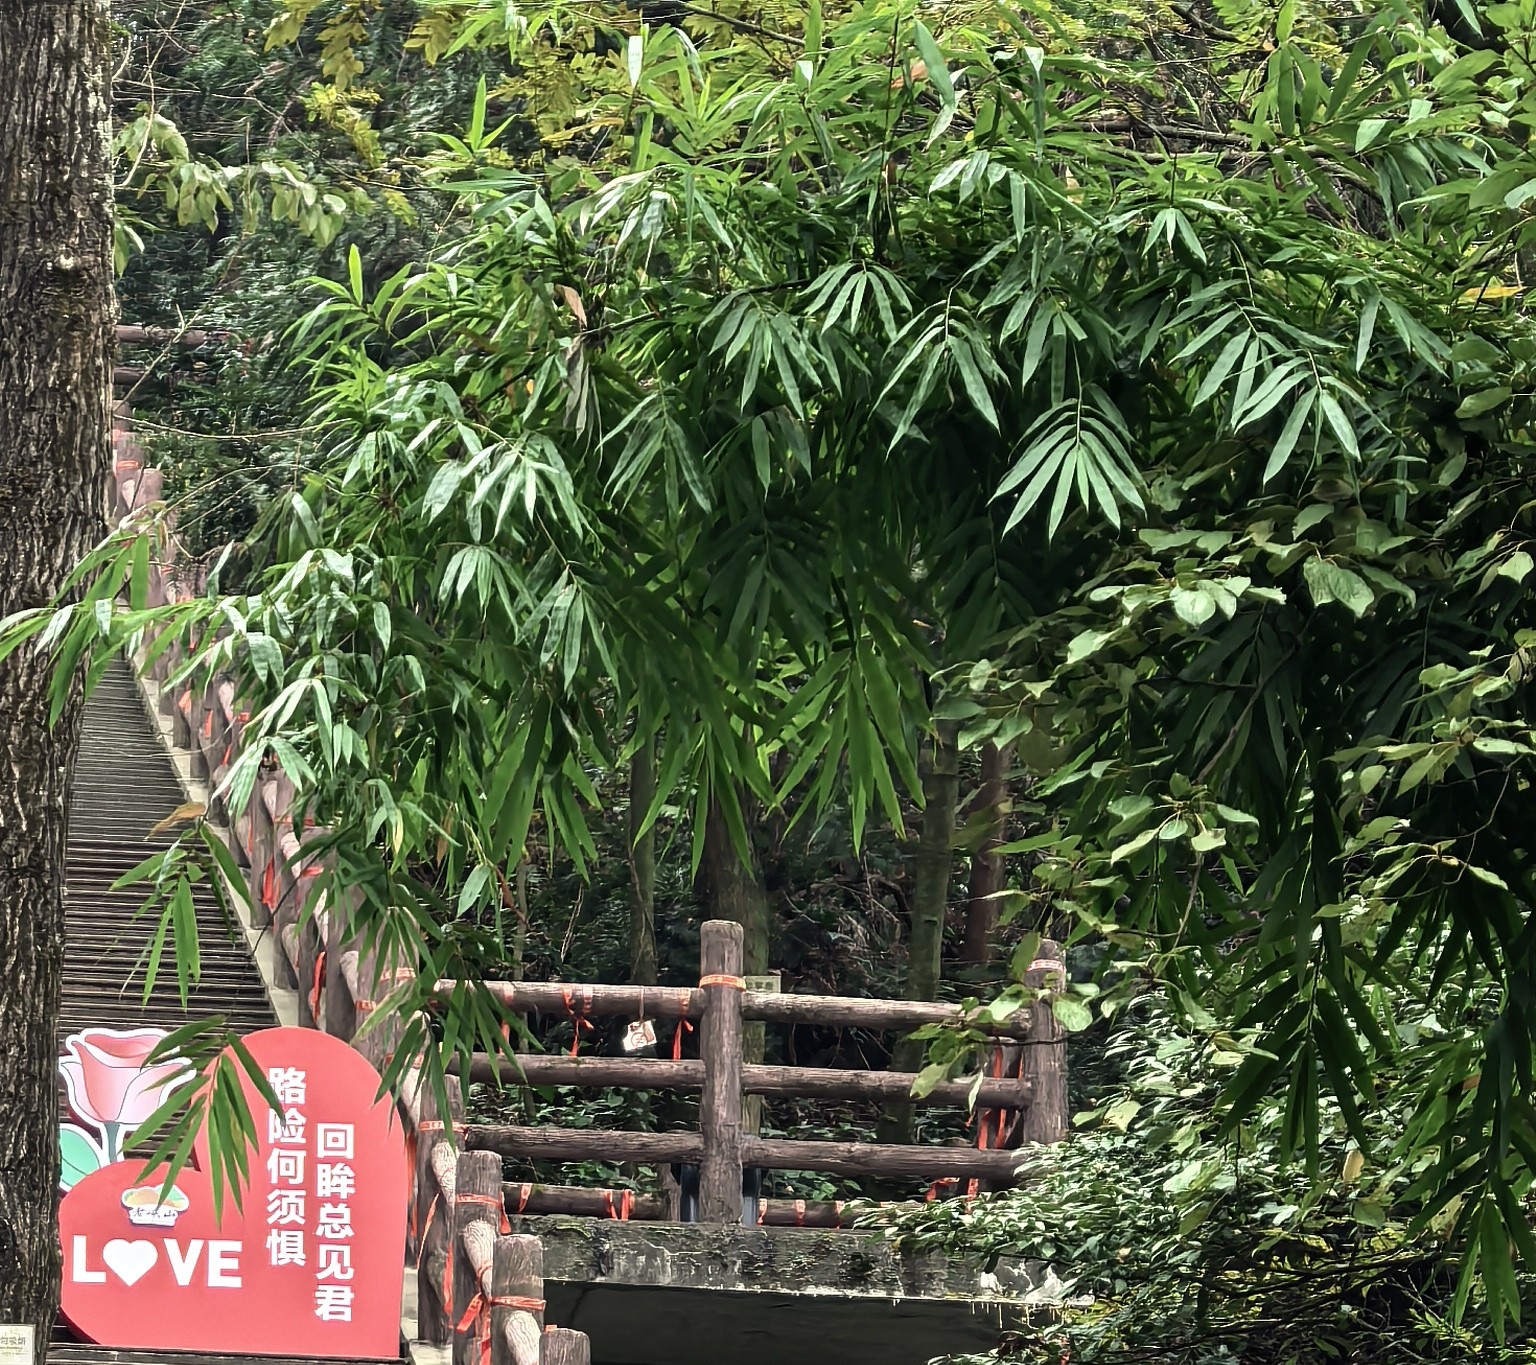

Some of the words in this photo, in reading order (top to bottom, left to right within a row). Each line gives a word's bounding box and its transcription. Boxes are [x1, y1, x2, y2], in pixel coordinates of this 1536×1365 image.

[265, 1066, 307, 1267] 路险何须惧
[315, 1122, 356, 1322] 回眸总见君
